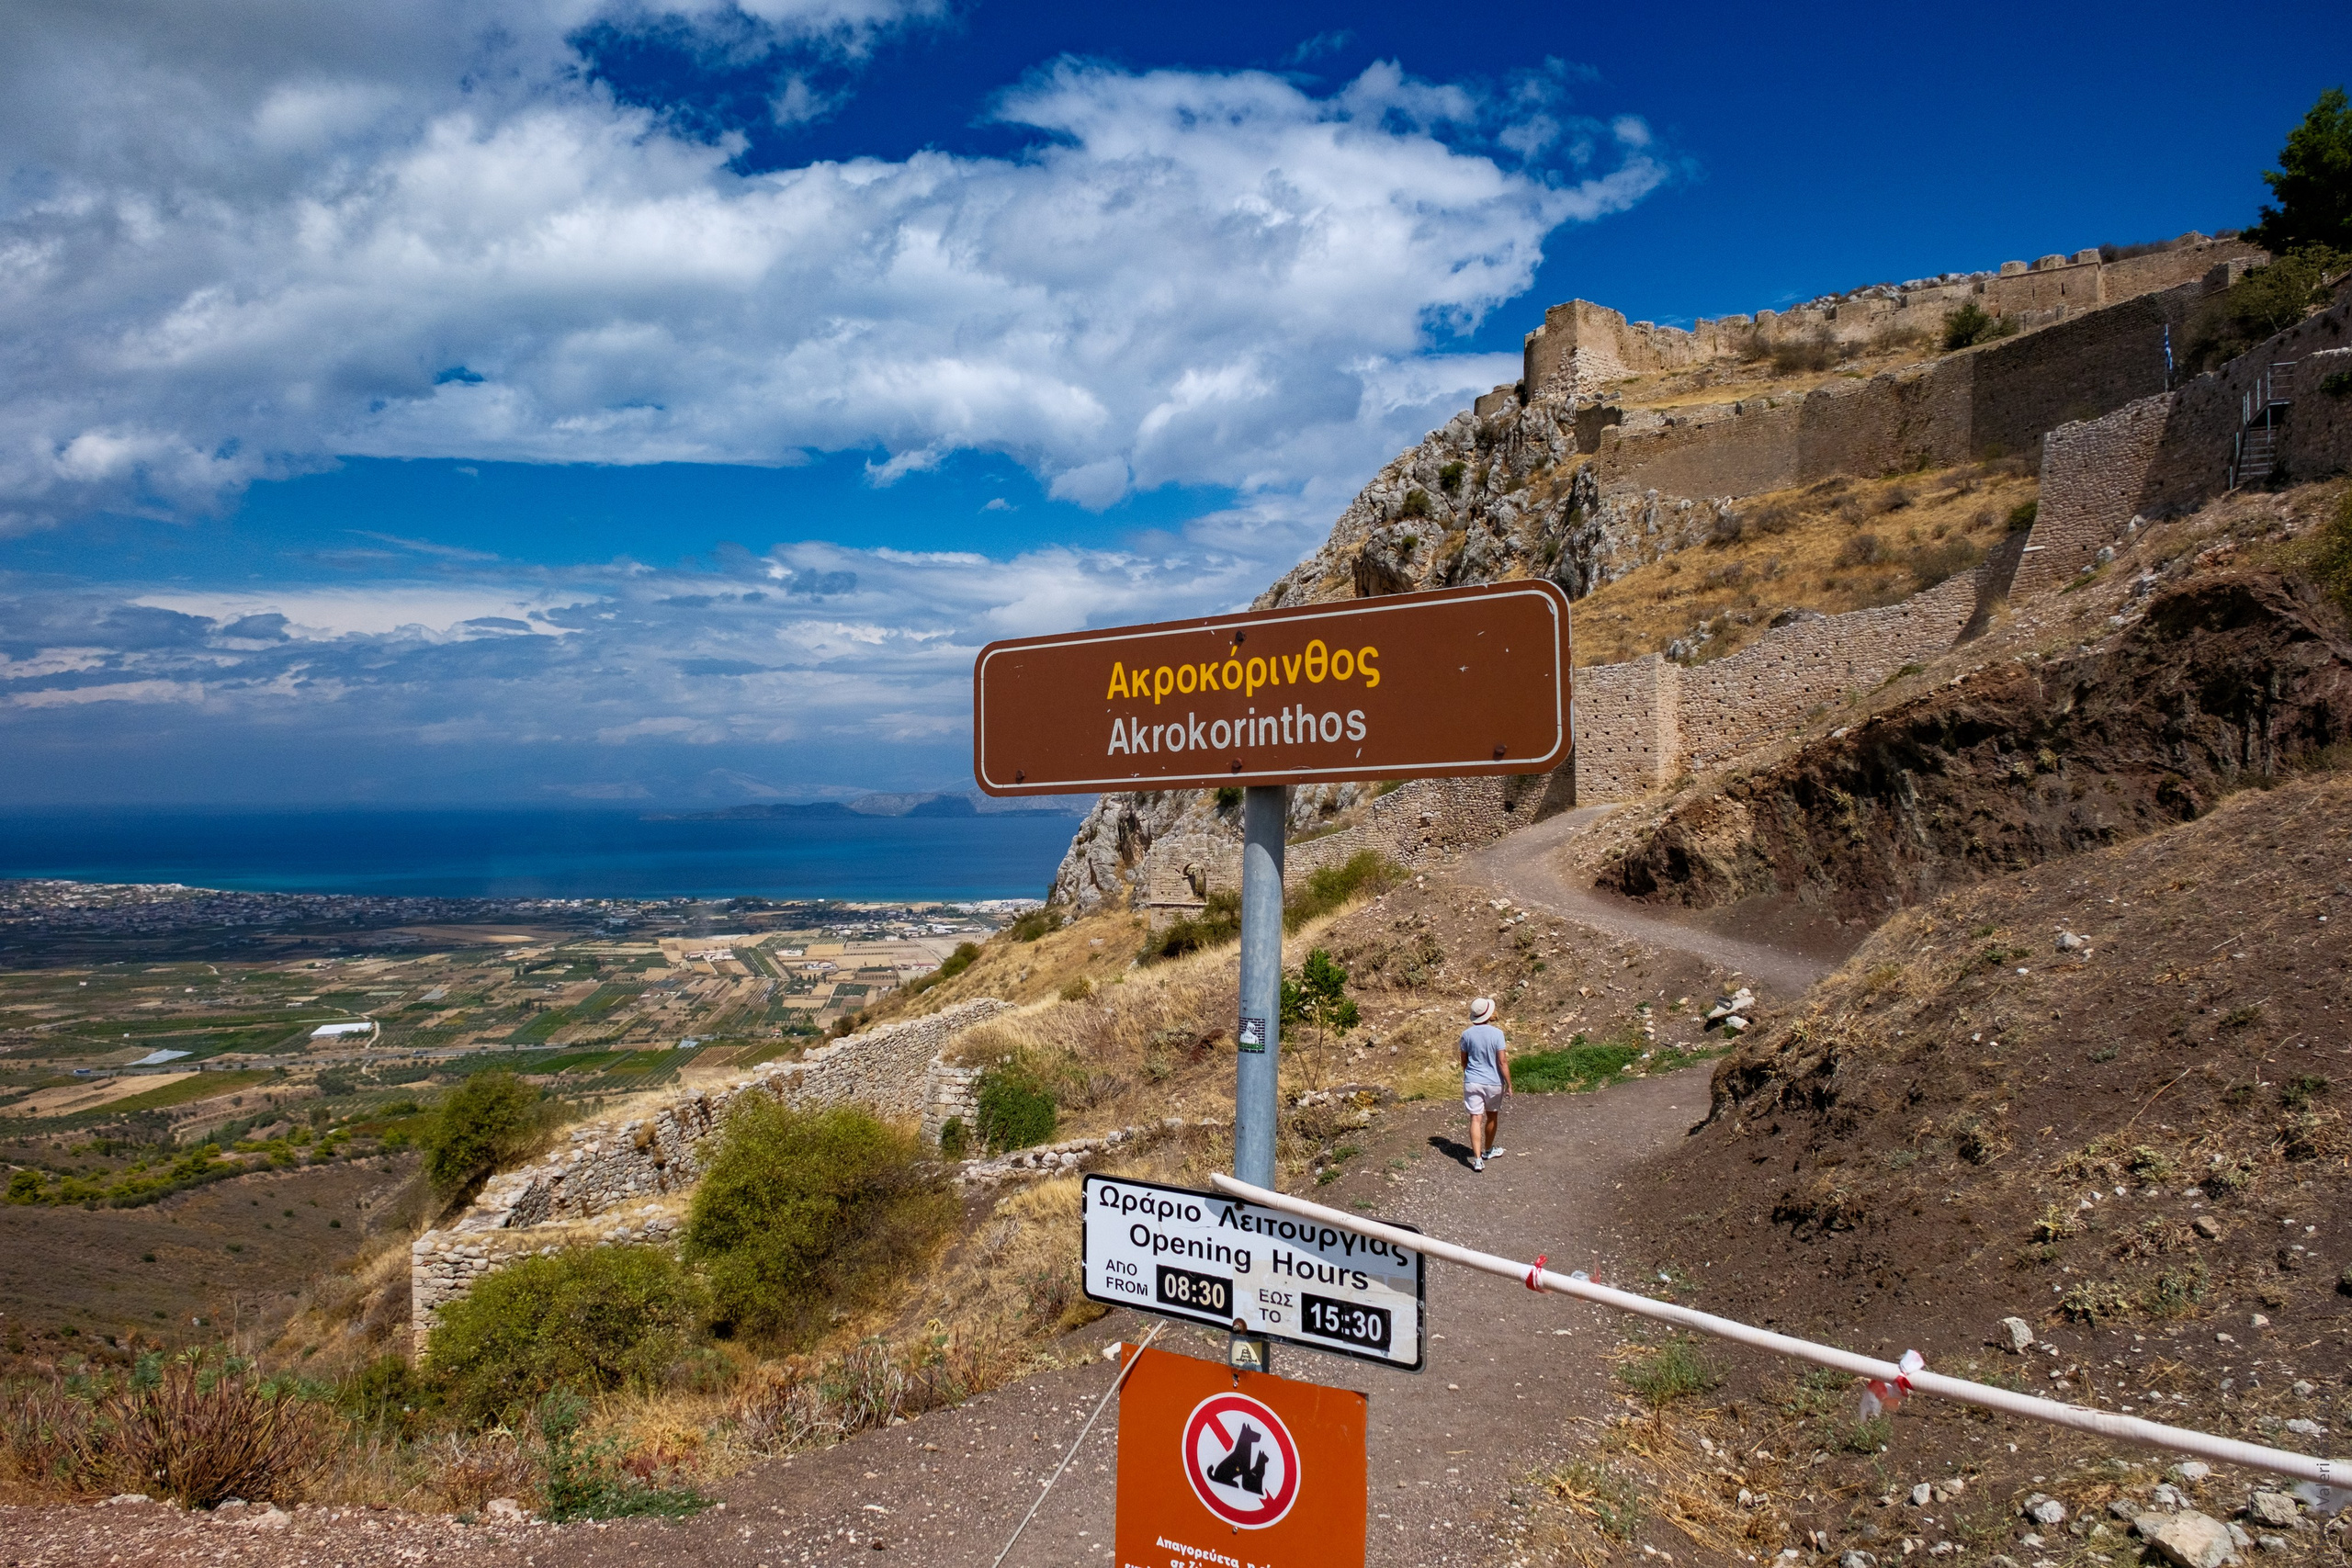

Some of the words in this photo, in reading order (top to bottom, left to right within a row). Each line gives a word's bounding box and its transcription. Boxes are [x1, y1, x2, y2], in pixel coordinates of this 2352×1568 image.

[1106, 638, 1381, 705] Ακροκόρινθος
[1107, 704, 1367, 756] Akrokorinthos
[1099, 1185, 1202, 1223] Ωράριο
[1105, 1258, 1138, 1276] ΑΠΟ
[1129, 1224, 1251, 1274] Opening
[1272, 1248, 1369, 1291] Hours
[1105, 1276, 1148, 1297] FROM
[1164, 1273, 1226, 1309] 08:30
[1259, 1288, 1294, 1308] ΕΩΣ
[1310, 1303, 1383, 1342] 15:30
